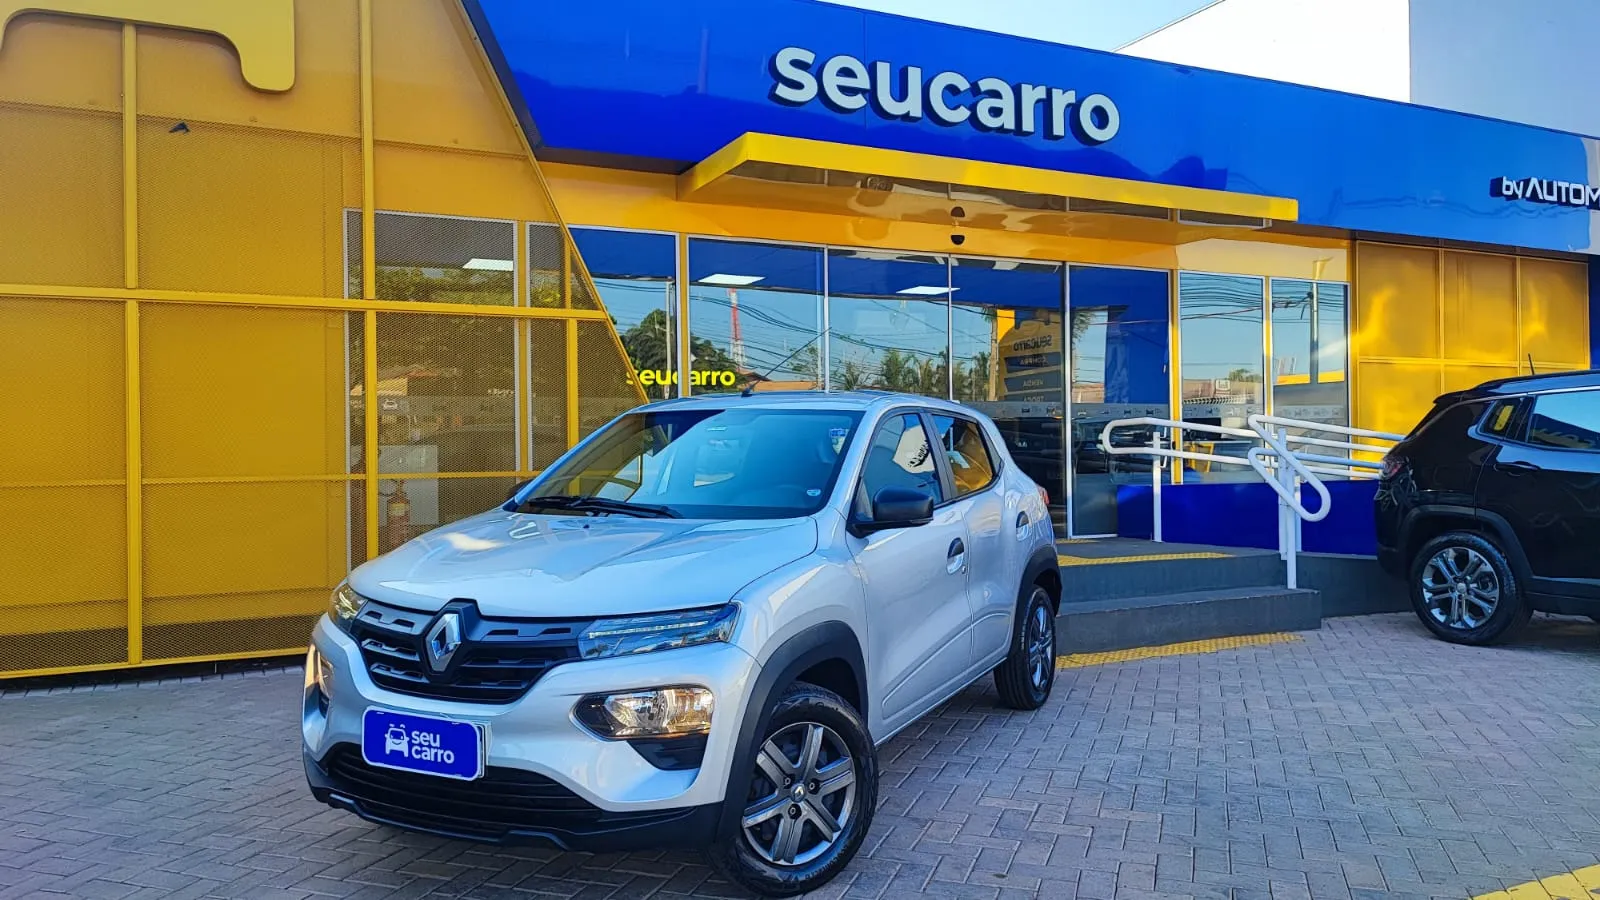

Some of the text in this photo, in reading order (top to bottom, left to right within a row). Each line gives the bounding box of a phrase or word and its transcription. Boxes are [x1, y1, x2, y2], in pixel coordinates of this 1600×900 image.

[773, 46, 1121, 143] seucarro
[411, 730, 440, 748] seu
[411, 745, 455, 764] carro
